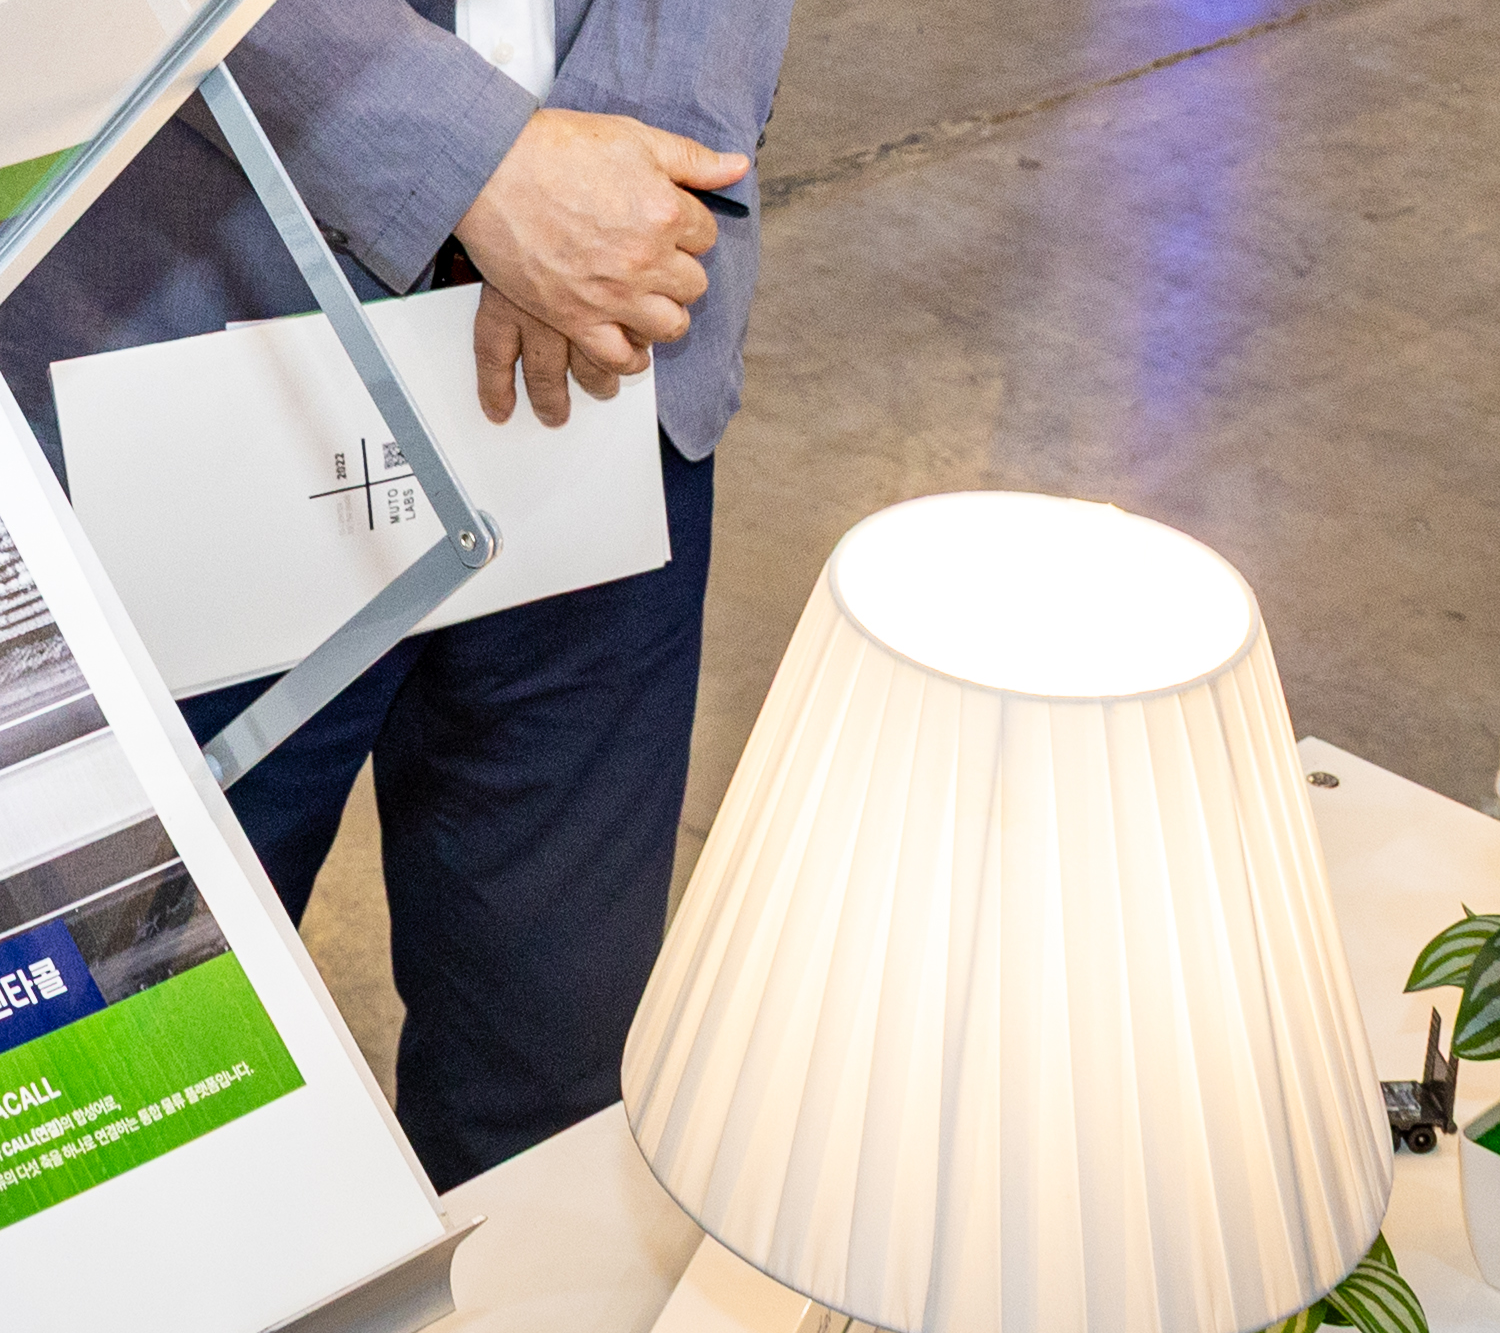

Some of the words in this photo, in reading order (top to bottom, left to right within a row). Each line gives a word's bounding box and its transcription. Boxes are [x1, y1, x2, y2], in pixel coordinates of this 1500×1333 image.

[335, 453, 347, 480] 2022
[388, 488, 400, 524] MUTO
[403, 488, 416, 521] LABS
[1, 1112, 75, 1156] CALL(연결)의
[73, 1093, 122, 1130] 합성어로,
[17, 1160, 42, 1183] 다섯
[40, 1147, 63, 1172] 축을
[62, 1136, 97, 1166] 하나로
[94, 1115, 140, 1150] 연결하는
[139, 1104, 163, 1129] 통합
[161, 1094, 187, 1120] 물류
[184, 1060, 255, 1108] 플랫폼입니다.
